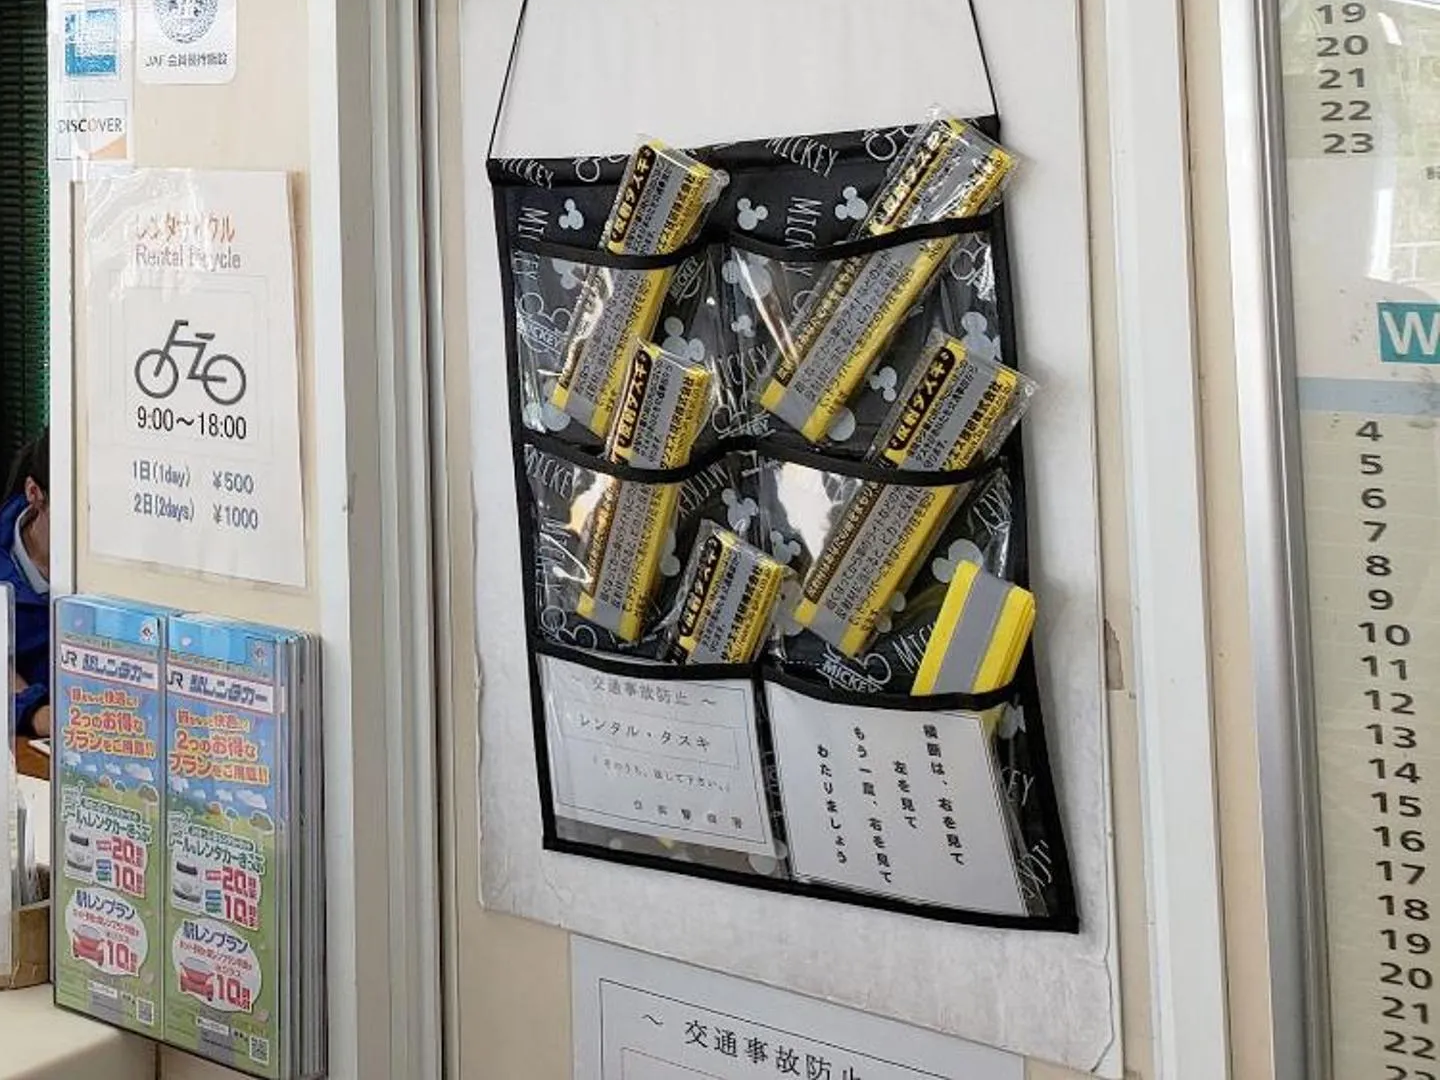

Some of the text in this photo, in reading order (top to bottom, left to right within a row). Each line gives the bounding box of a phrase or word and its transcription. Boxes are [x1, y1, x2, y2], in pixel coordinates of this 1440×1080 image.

[1316, 3, 1366, 25] 19
[1316, 35, 1368, 57] 20
[1319, 68, 1365, 89] 21
[1321, 101, 1372, 121] 22
[58, 118, 123, 133] DISCOVER
[1323, 133, 1374, 154] 23
[1382, 311, 1440, 355] W
[1356, 420, 1384, 442] 4
[1360, 454, 1384, 475] 5
[1360, 488, 1387, 510] 6
[1363, 521, 1387, 543] 7
[1365, 554, 1392, 577] 8
[1368, 589, 1394, 611] 9
[1358, 622, 1411, 646] 10
[62, 649, 153, 682] JR 駅レンタカー
[1361, 655, 1408, 681] 11
[168, 670, 268, 705] JR 駅レンタカー
[1364, 689, 1416, 715] 12
[1366, 723, 1417, 749] 13
[1369, 758, 1421, 784] 14
[1371, 792, 1422, 818] 15
[1373, 825, 1426, 852] 16
[1376, 860, 1426, 886] 17
[1378, 894, 1430, 922] 18
[1380, 929, 1431, 955] 19
[1380, 962, 1434, 990] 20
[1382, 996, 1429, 1024] 21
[1384, 1030, 1437, 1060] 22
